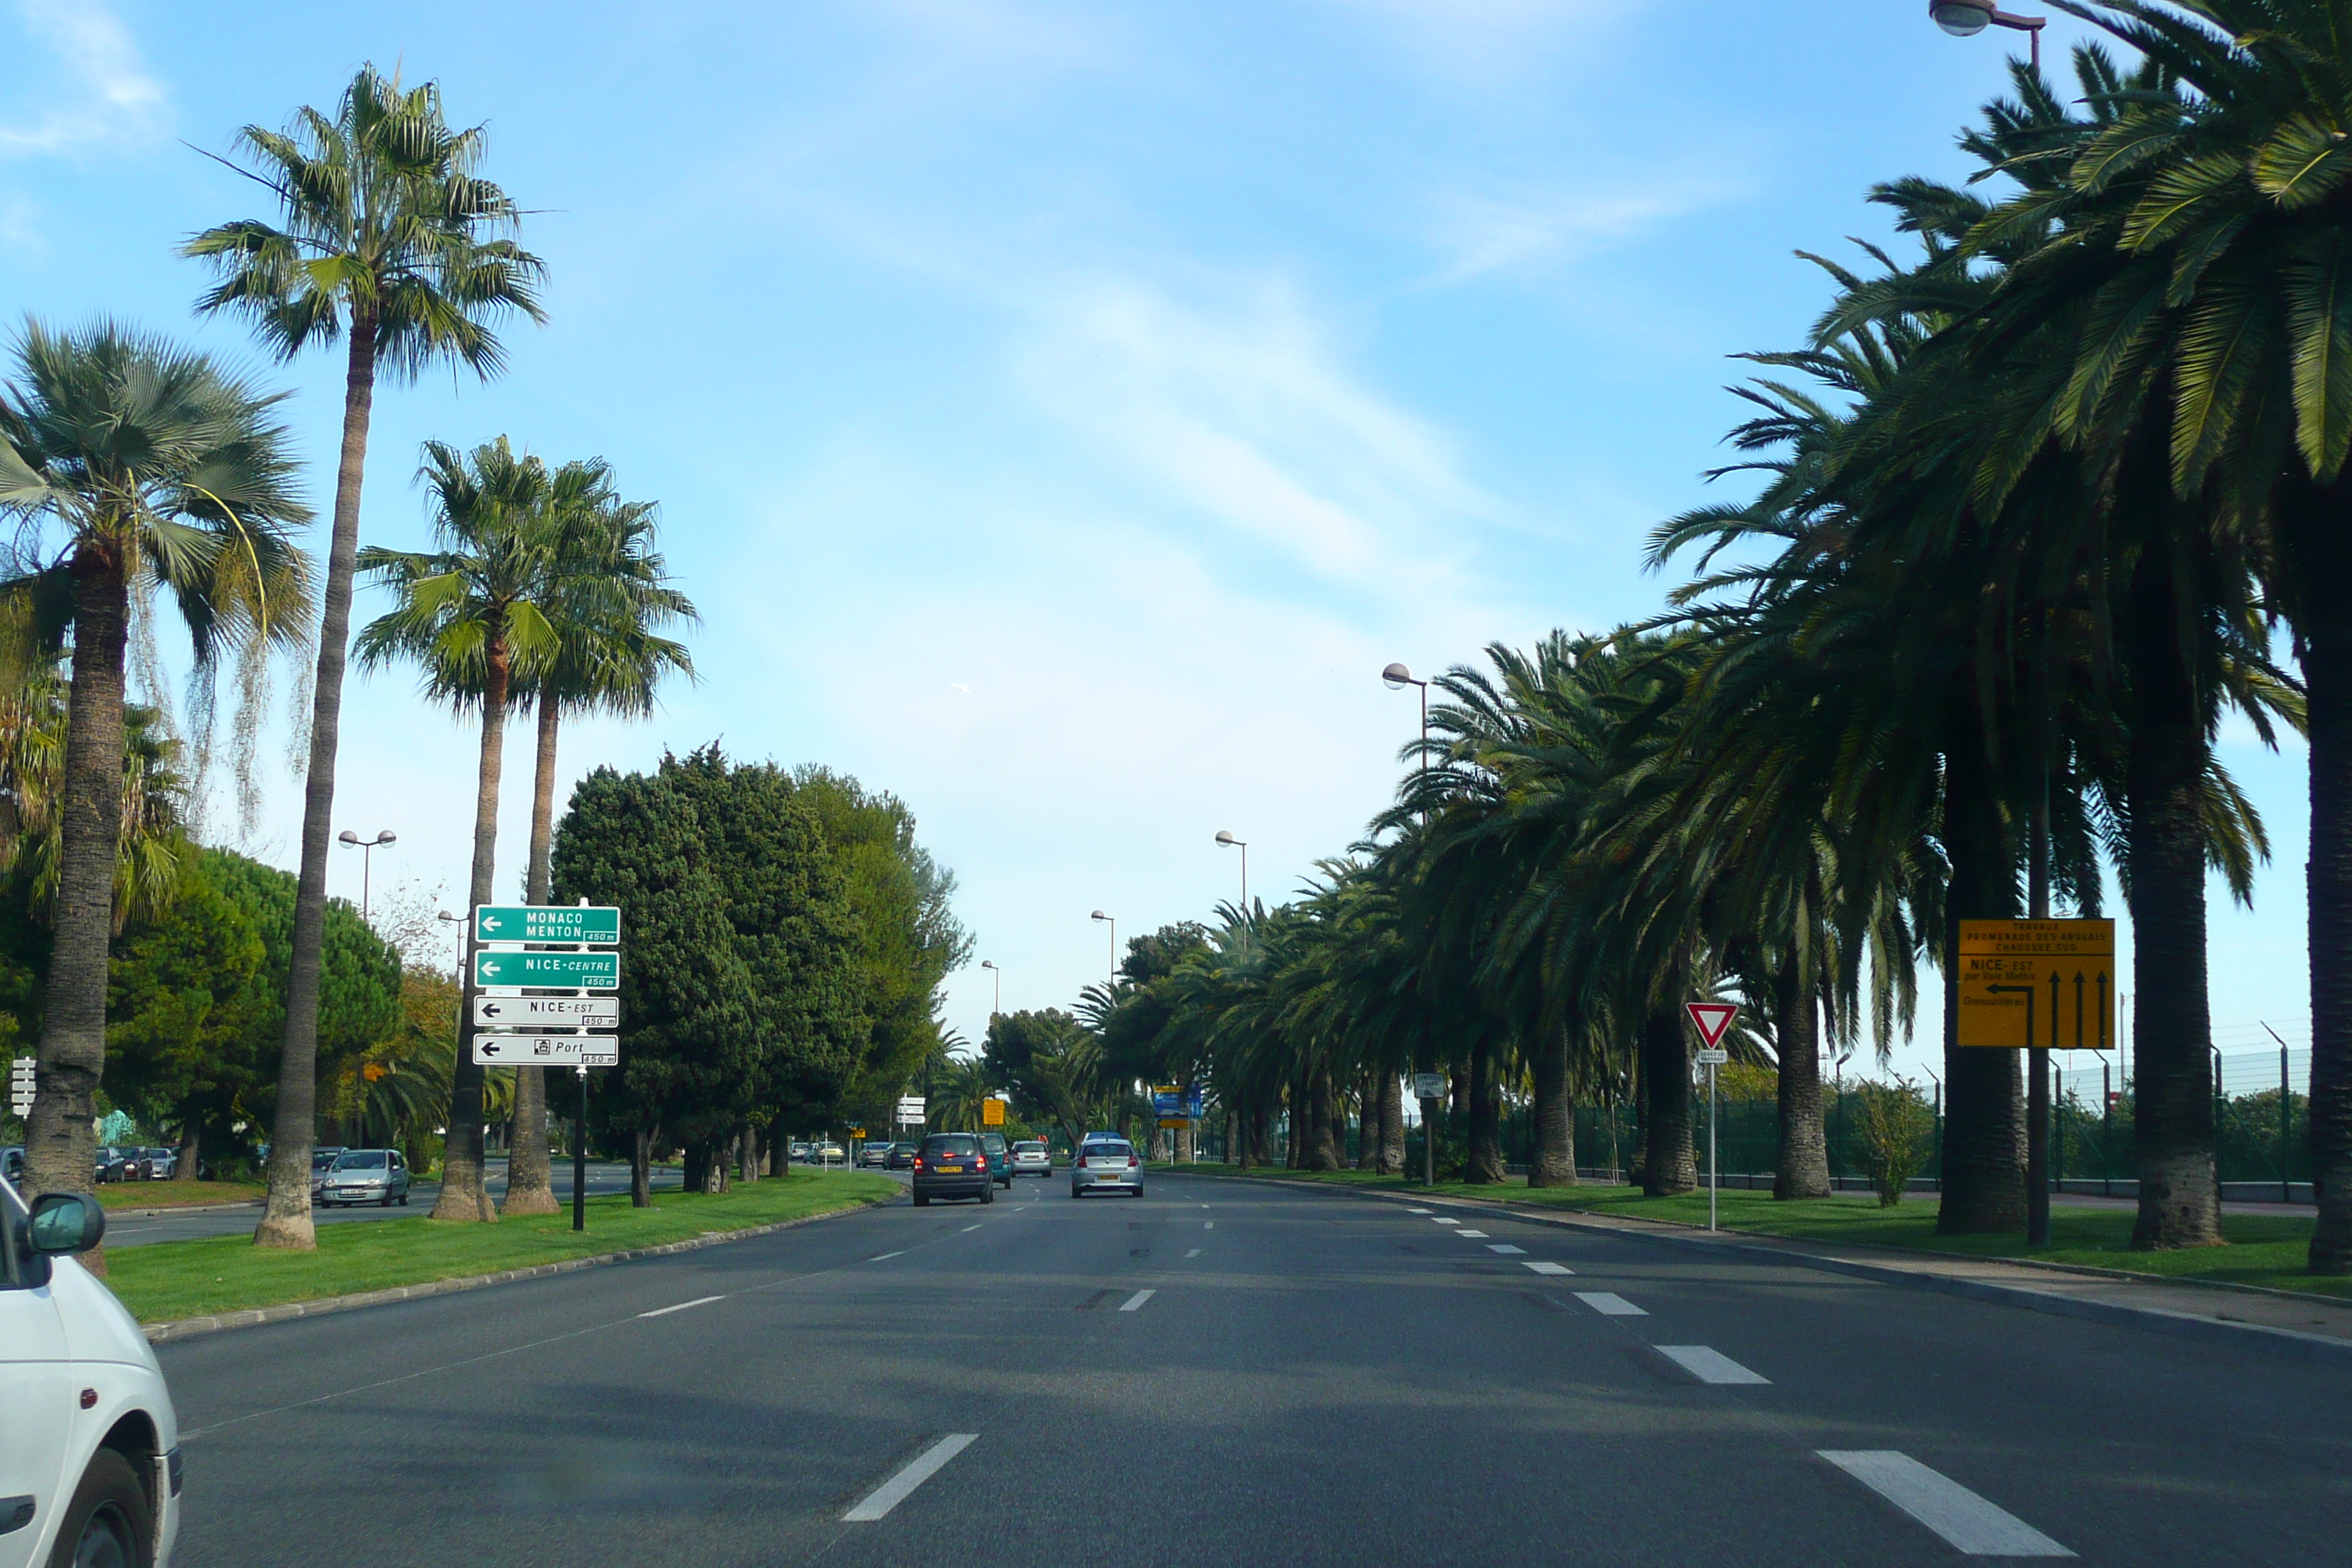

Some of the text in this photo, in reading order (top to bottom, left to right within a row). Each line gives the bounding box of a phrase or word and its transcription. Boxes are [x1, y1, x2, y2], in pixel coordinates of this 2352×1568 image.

[527, 913, 582, 924] MONACO
[2013, 922, 2059, 930] TRAVAUX
[526, 926, 581, 937] MENTON
[1967, 932, 2106, 942] PROMENADE DES ANGLAIS
[2055, 943, 2077, 951] SUD
[526, 959, 611, 971] NICE-CENTRE
[2013, 961, 2033, 970] EST
[530, 1002, 594, 1013] NICE-EST
[584, 1017, 603, 1025] 450
[556, 1041, 584, 1053] Port
